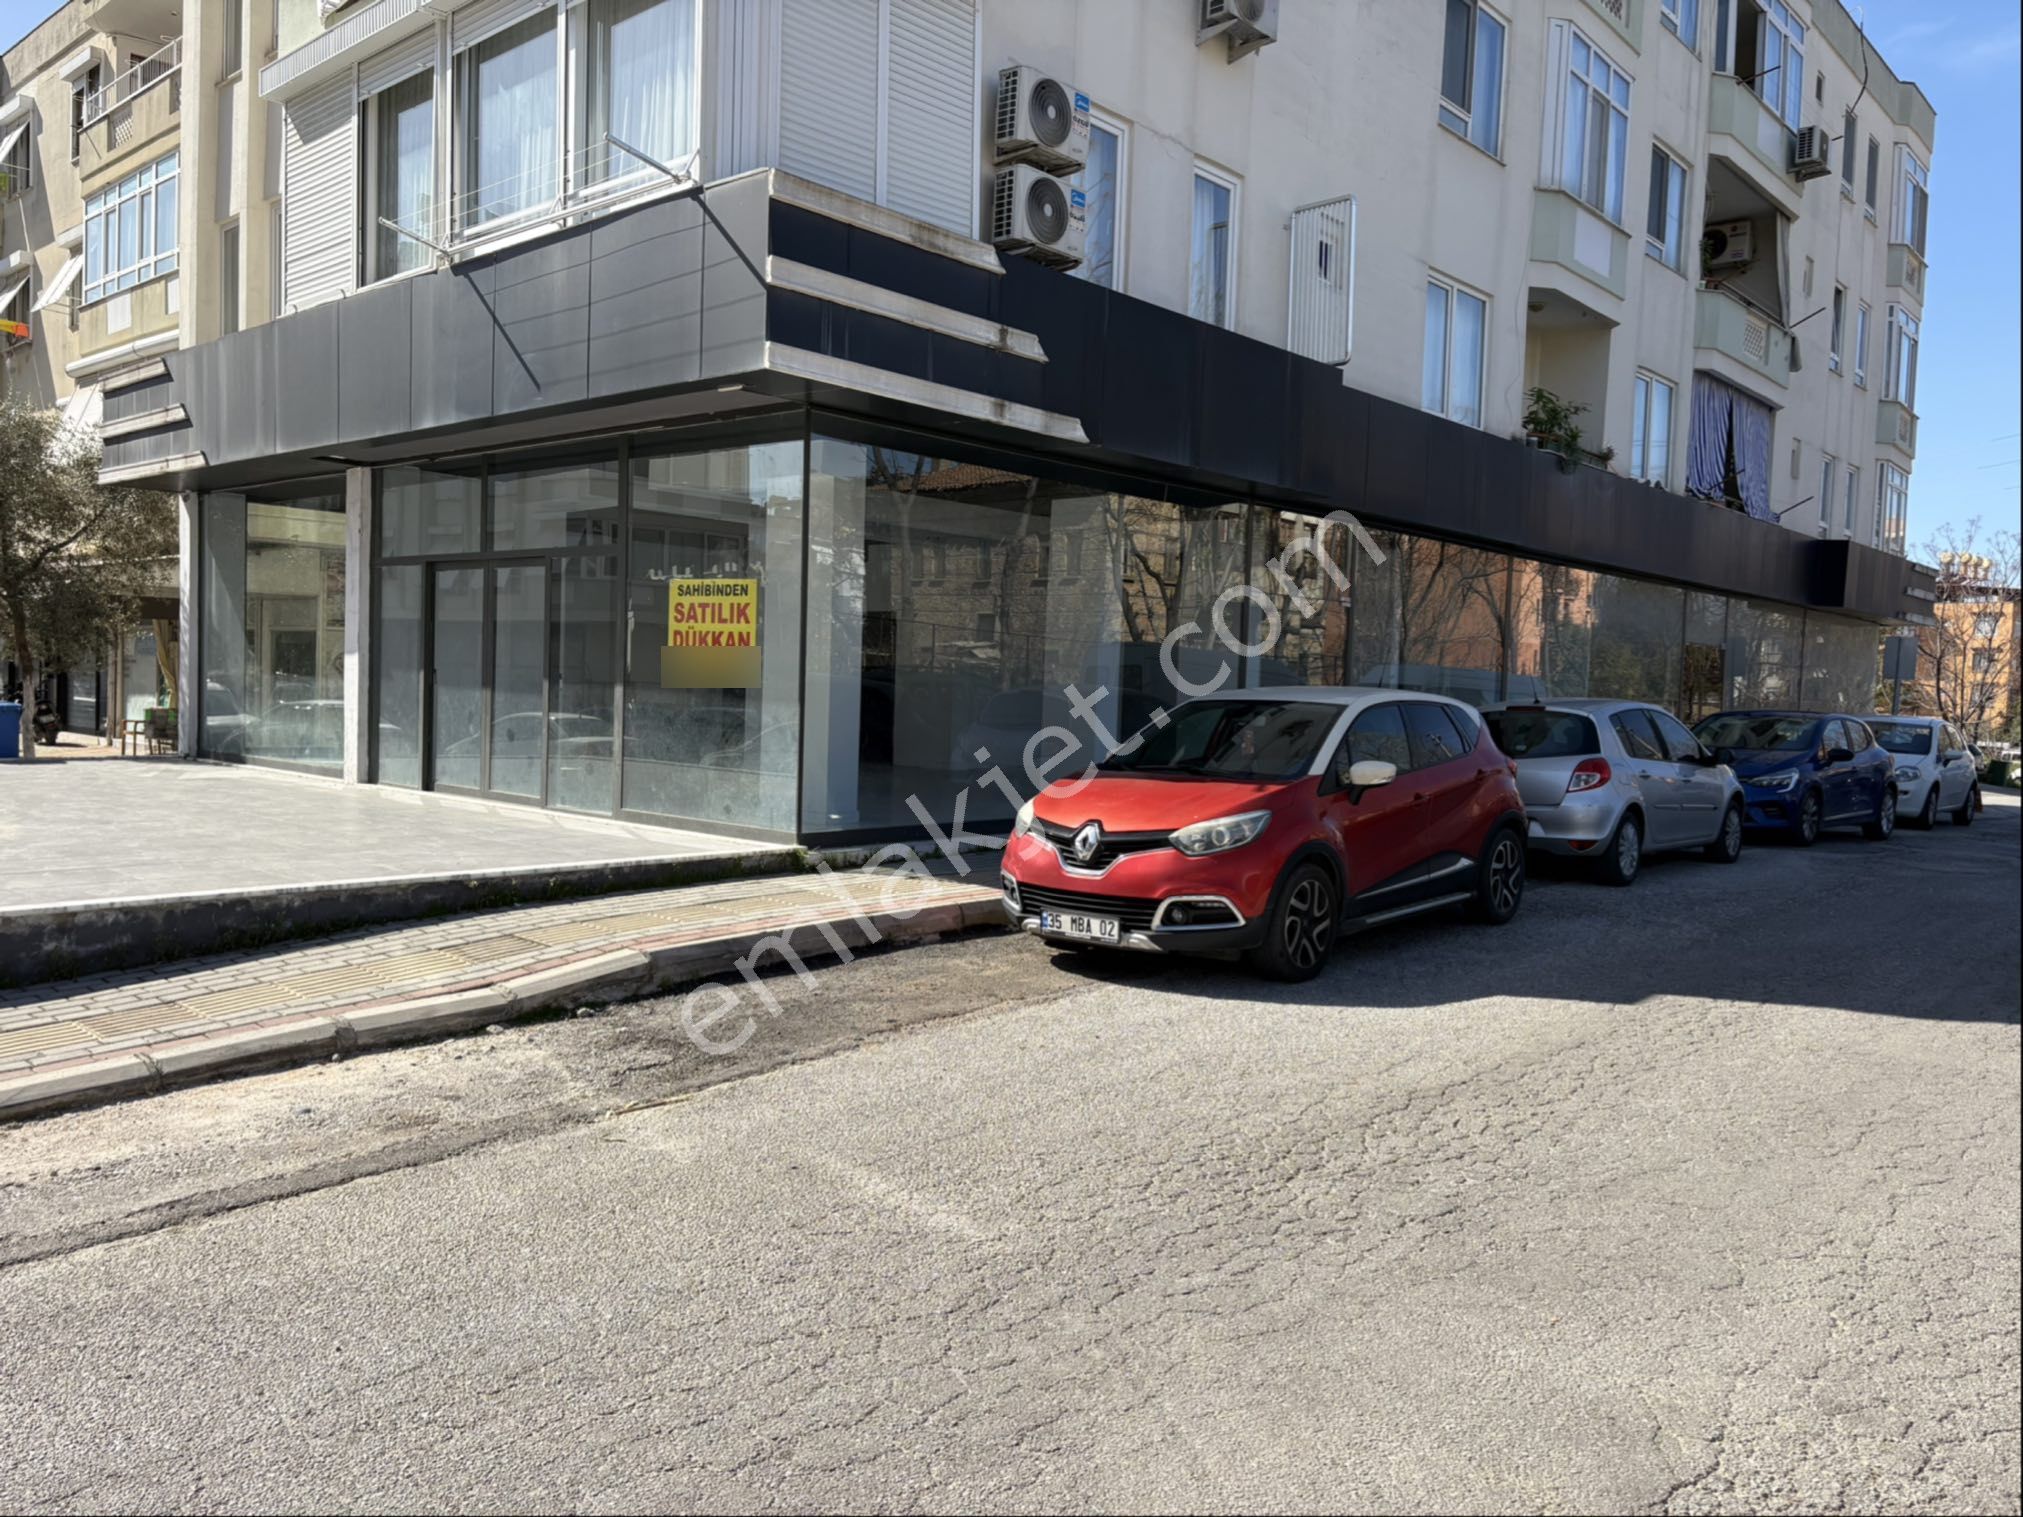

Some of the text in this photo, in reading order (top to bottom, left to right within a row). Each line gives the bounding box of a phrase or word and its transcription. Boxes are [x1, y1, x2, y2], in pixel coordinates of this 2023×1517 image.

[677, 581, 749, 597] SAHİBİNDEN
[674, 602, 751, 624] SATILIK
[673, 625, 751, 647] DÜKKAN
[1048, 913, 1062, 929] 35
[1070, 916, 1092, 934] MBA
[1100, 920, 1115, 937] 02
